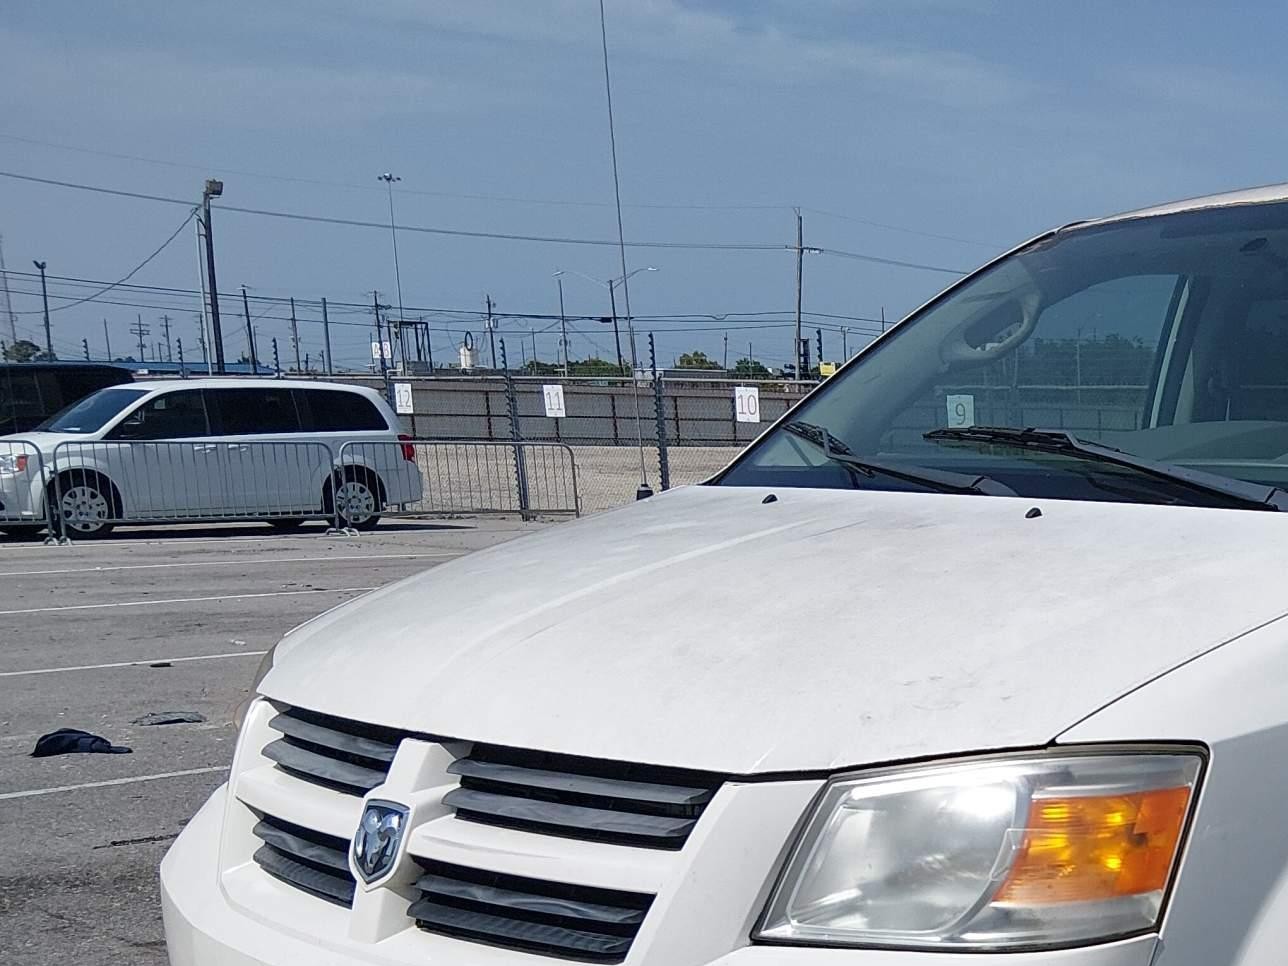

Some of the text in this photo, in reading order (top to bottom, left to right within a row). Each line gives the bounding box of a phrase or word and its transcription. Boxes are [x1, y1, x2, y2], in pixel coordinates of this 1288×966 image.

[397, 389, 412, 408] 12
[546, 391, 562, 412] 11
[737, 394, 758, 415] 10
[955, 403, 966, 426] 9
